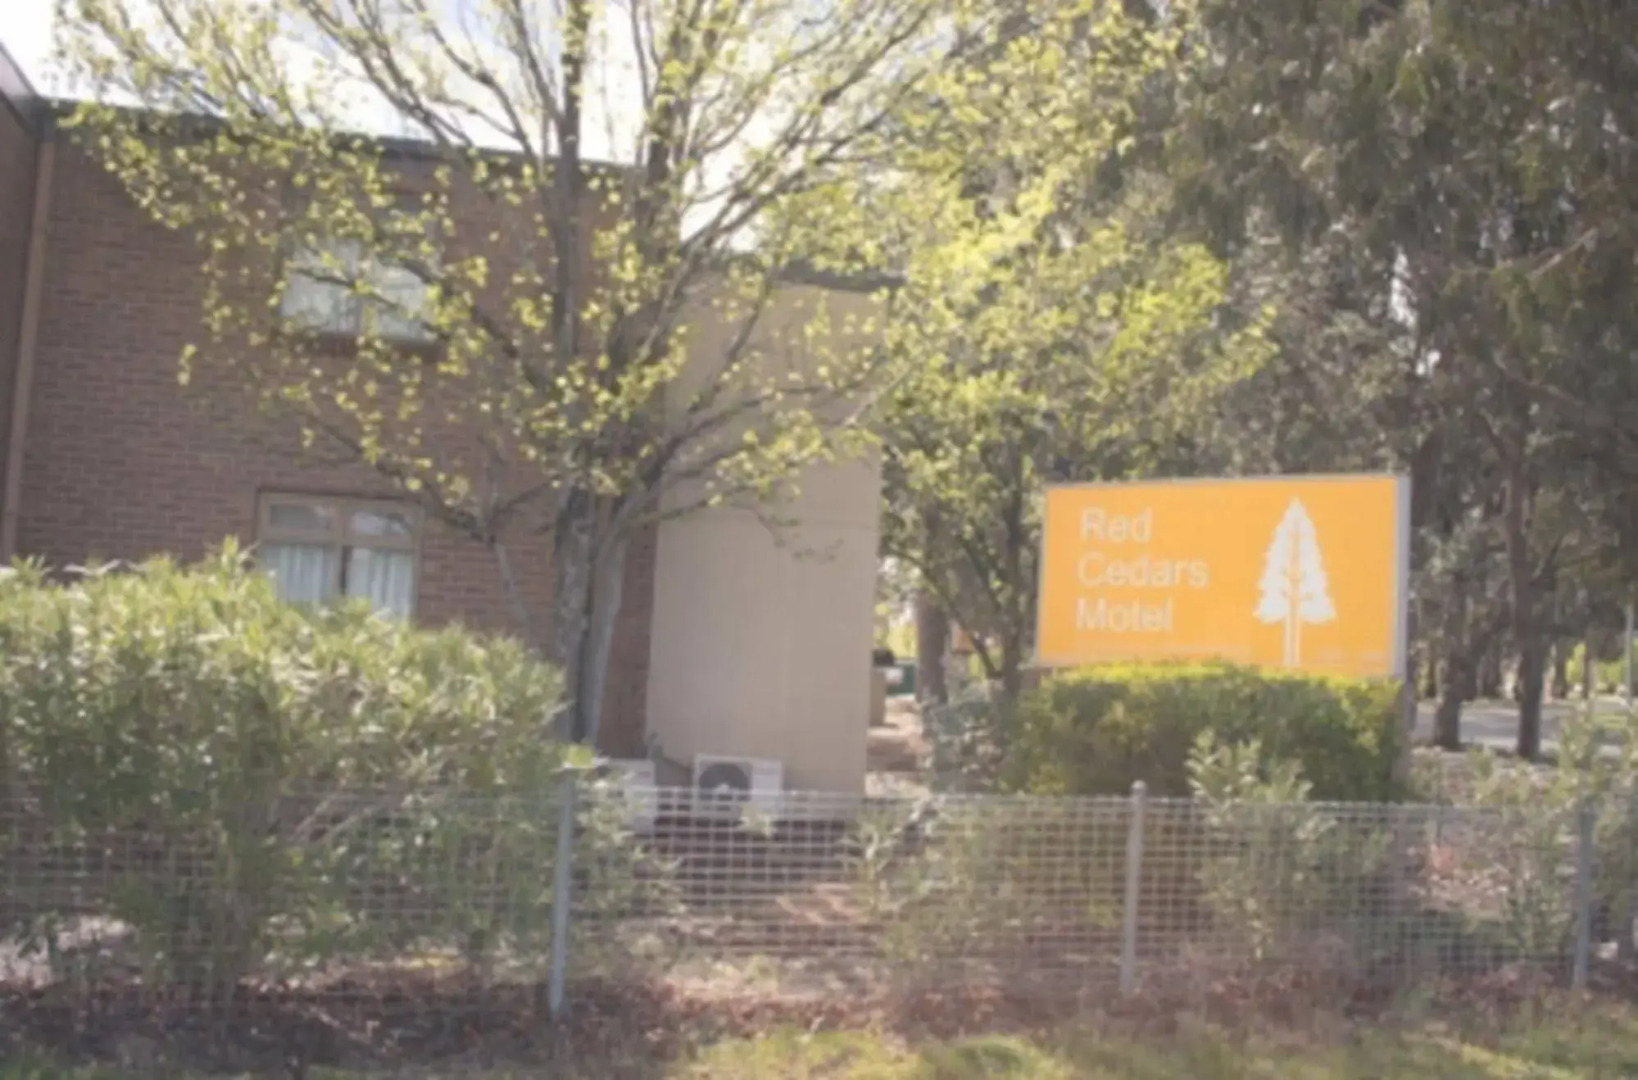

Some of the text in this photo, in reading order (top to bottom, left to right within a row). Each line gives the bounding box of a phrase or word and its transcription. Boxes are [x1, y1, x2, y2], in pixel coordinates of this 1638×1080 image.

[1081, 507, 1152, 542] Red
[1078, 553, 1208, 587] Cedars
[1077, 597, 1172, 631] Motel
